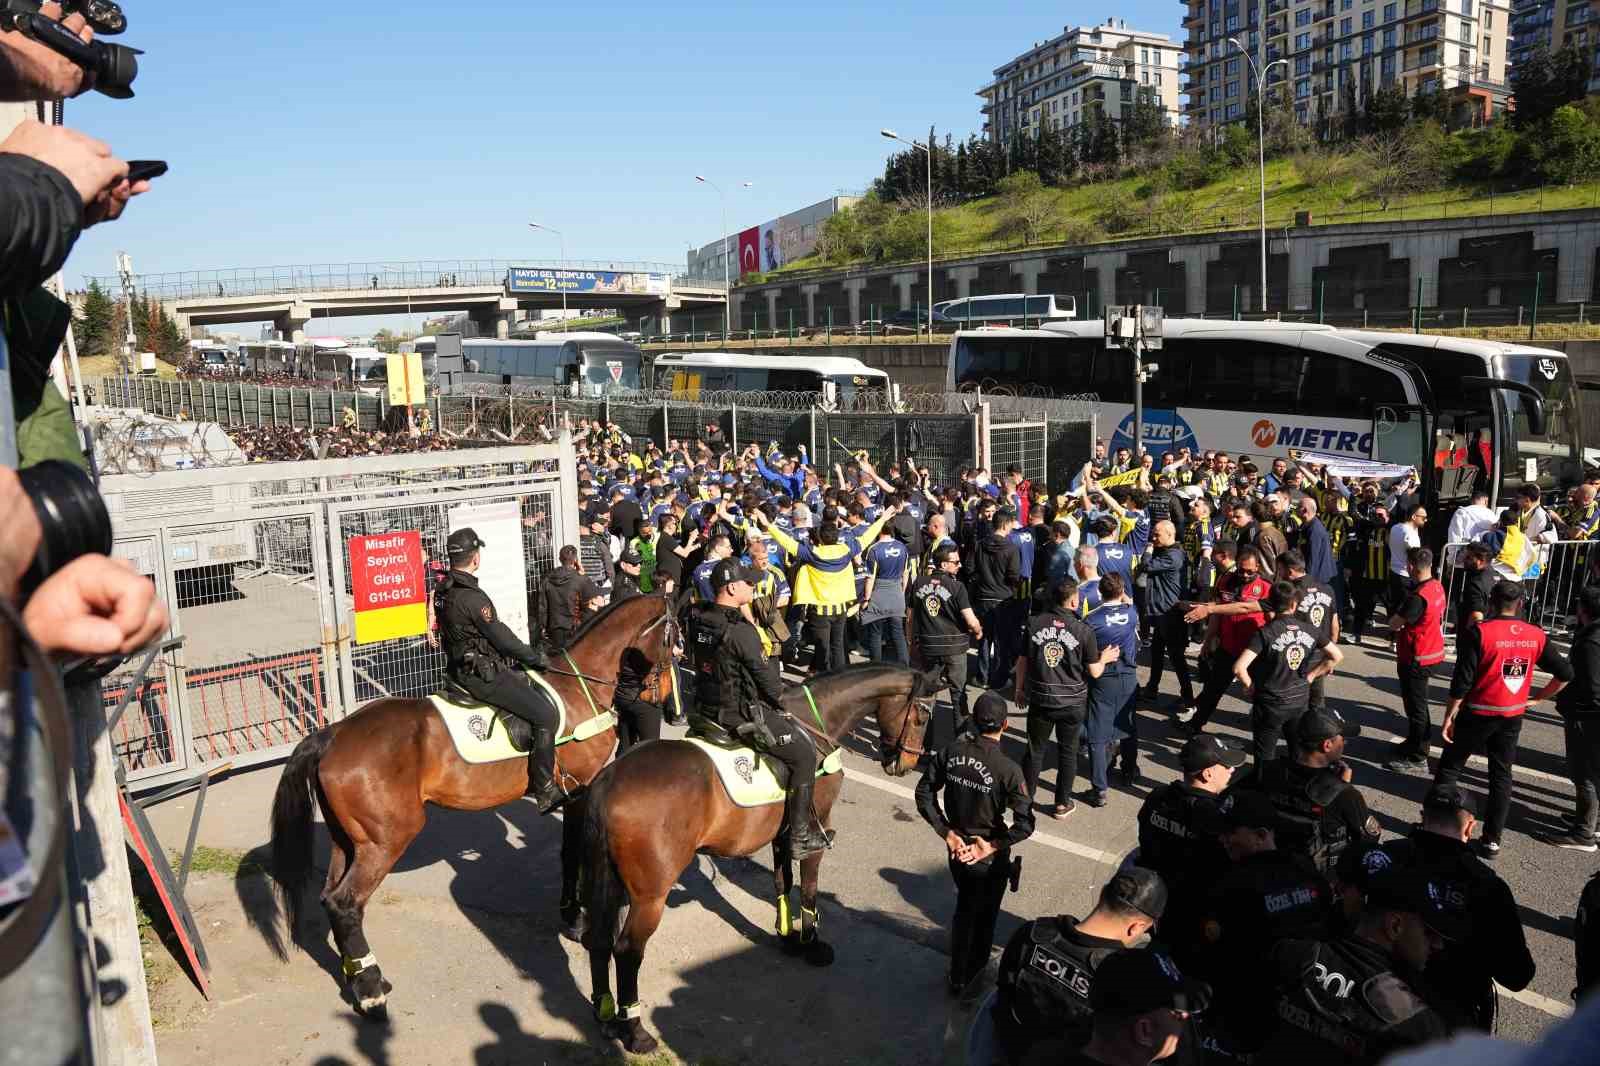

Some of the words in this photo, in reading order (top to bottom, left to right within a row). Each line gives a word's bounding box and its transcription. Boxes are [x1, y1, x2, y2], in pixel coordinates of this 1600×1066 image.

[366, 537, 405, 549] Misafir
[368, 553, 407, 566] Seyirci
[373, 572, 405, 585] Girişi
[369, 588, 411, 602] G11-G12
